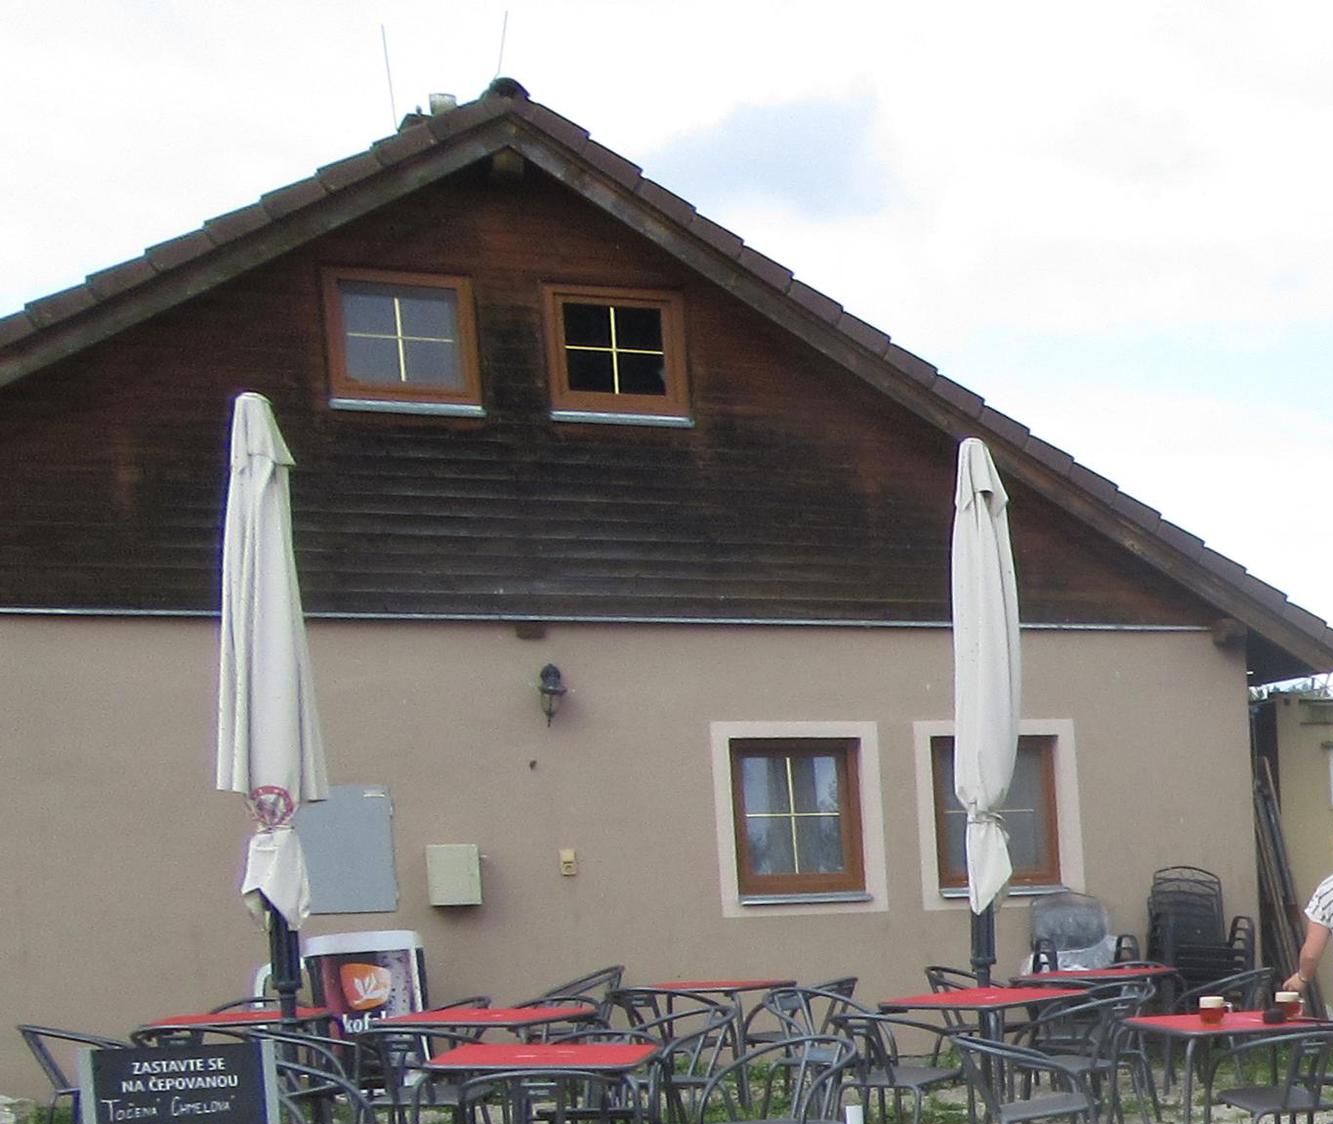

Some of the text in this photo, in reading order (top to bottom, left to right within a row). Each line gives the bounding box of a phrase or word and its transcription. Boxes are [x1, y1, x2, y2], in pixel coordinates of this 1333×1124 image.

[132, 1058, 225, 1075] ZASTAVTE SE
[121, 1075, 238, 1093] NA ČEPOVANOU
